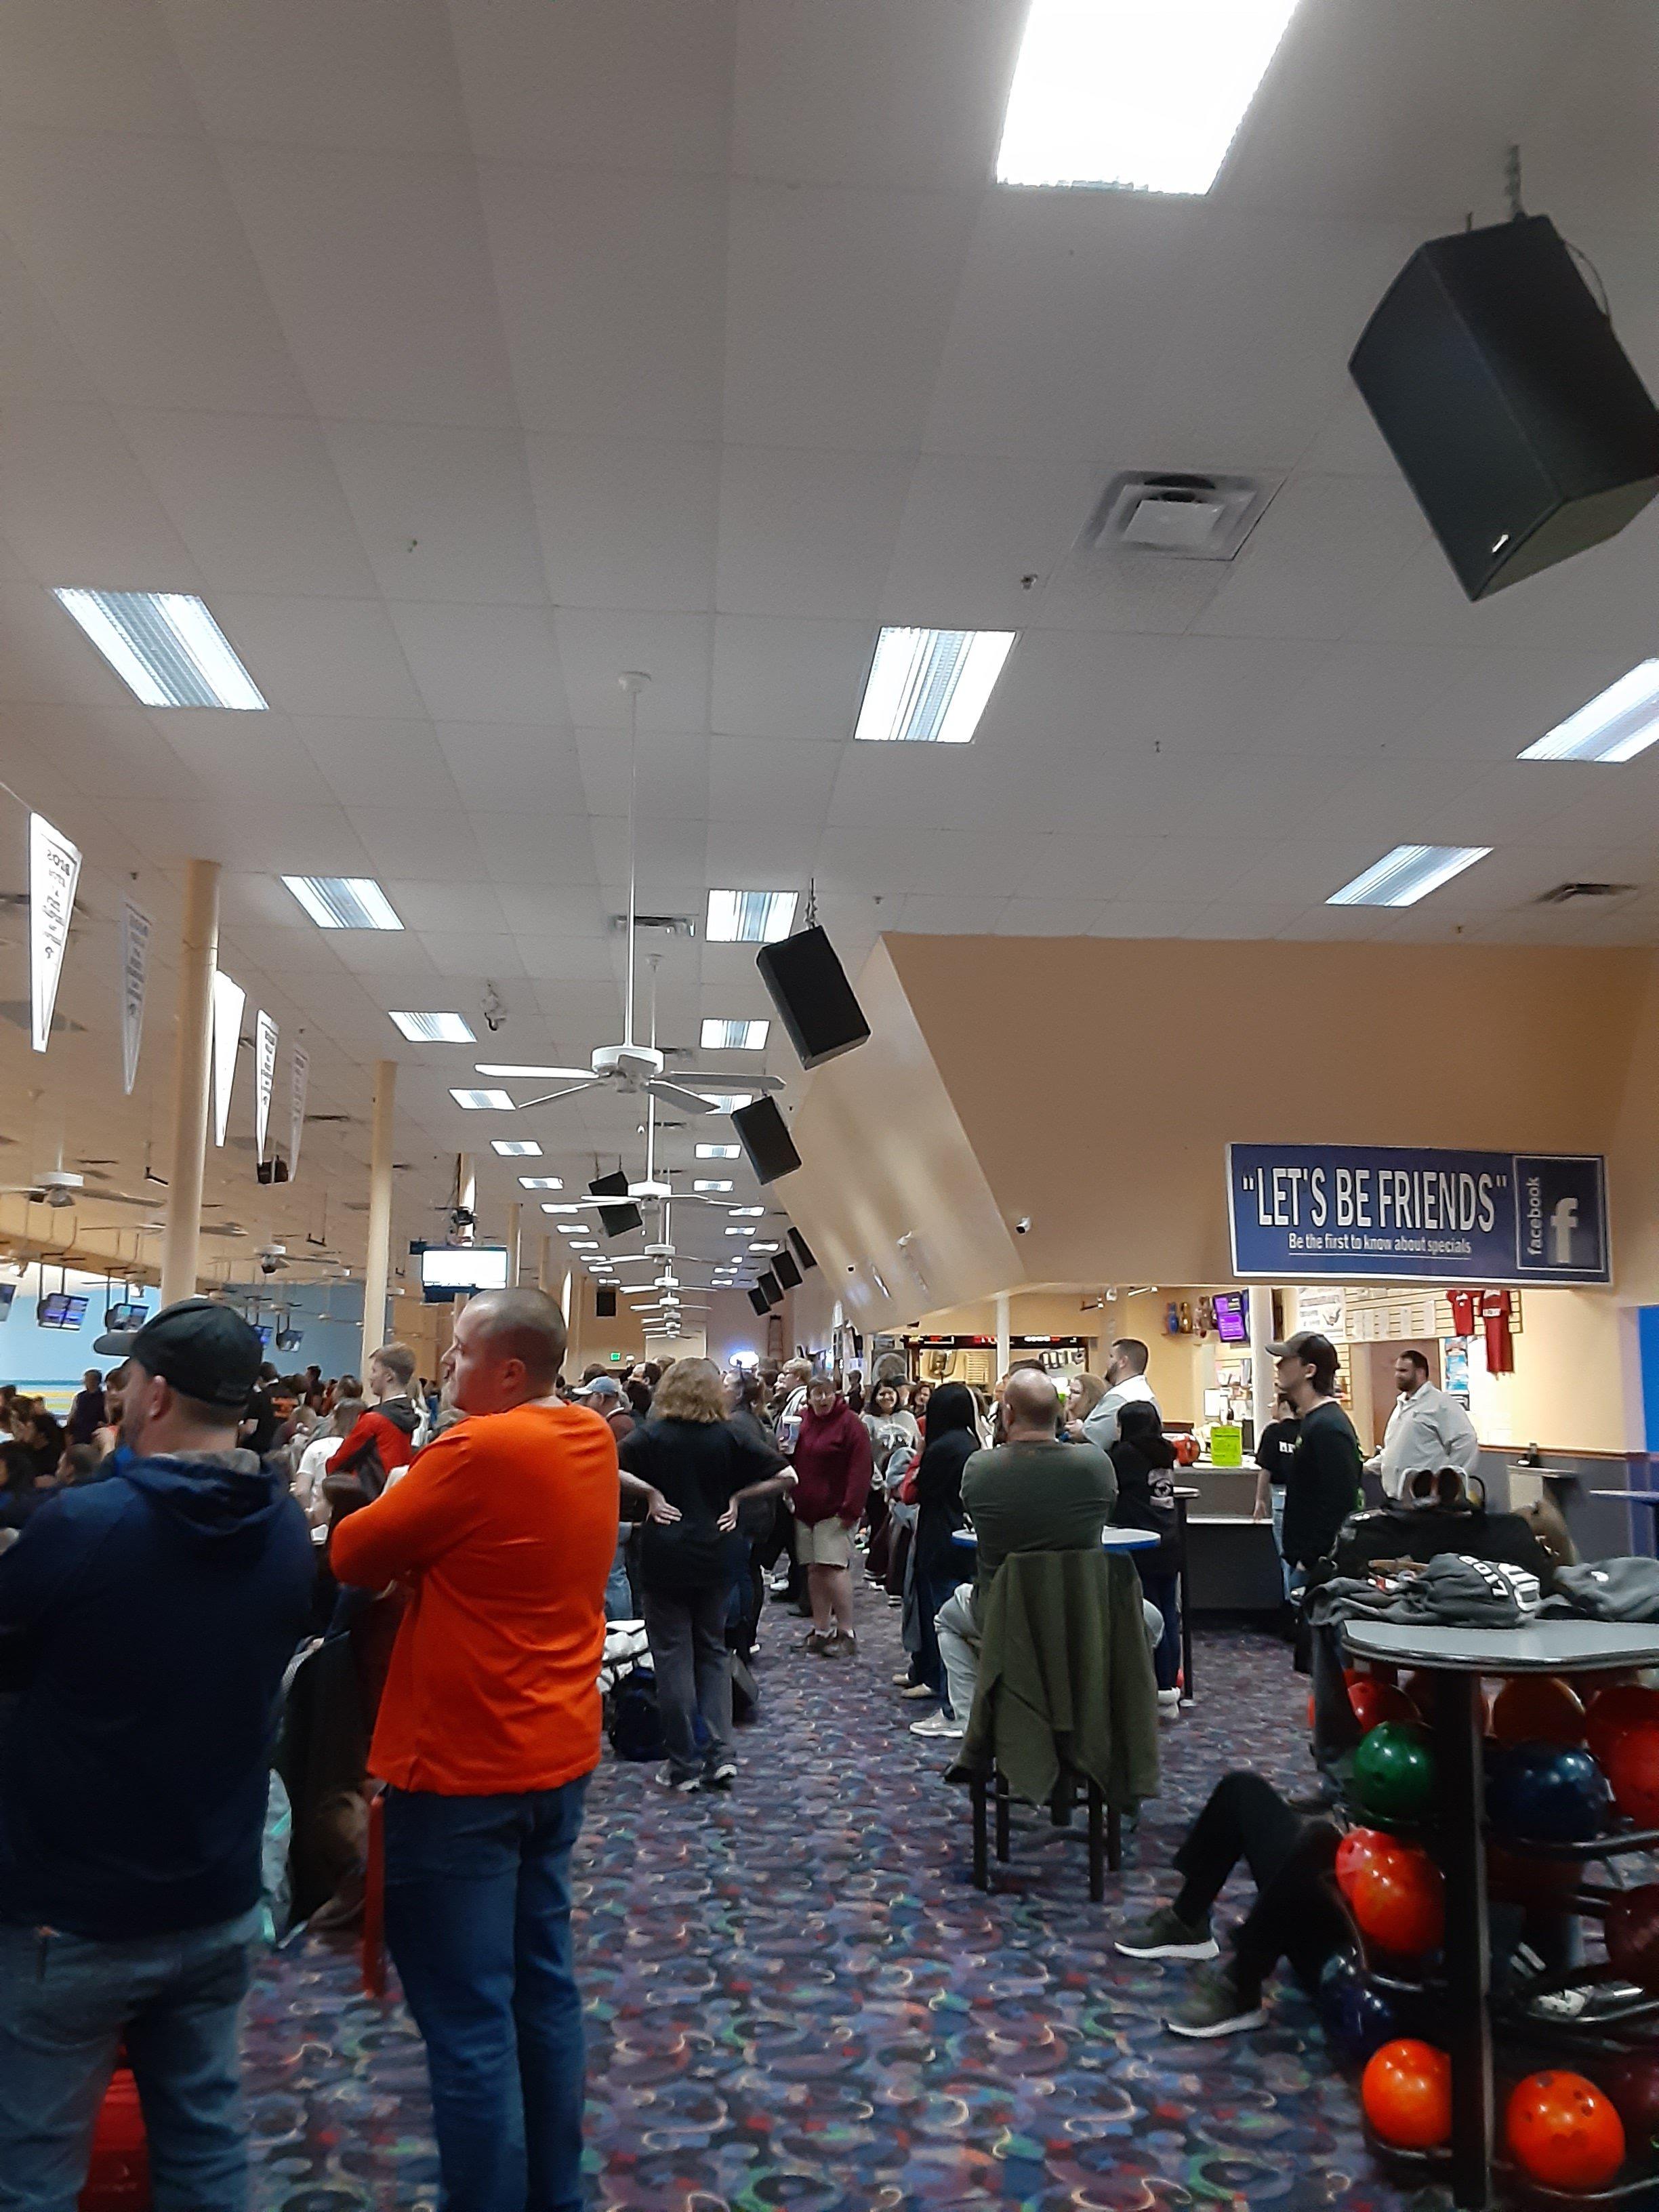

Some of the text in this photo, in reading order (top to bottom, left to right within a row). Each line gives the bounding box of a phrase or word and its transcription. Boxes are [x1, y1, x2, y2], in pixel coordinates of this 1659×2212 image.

[1243, 1167, 1507, 1232] "LET'S BE FRIENDS"
[1525, 1176, 1542, 1255] facebook
[1551, 1197, 1578, 1263] f
[1289, 1233, 1472, 1255] Be the first to know about specials
